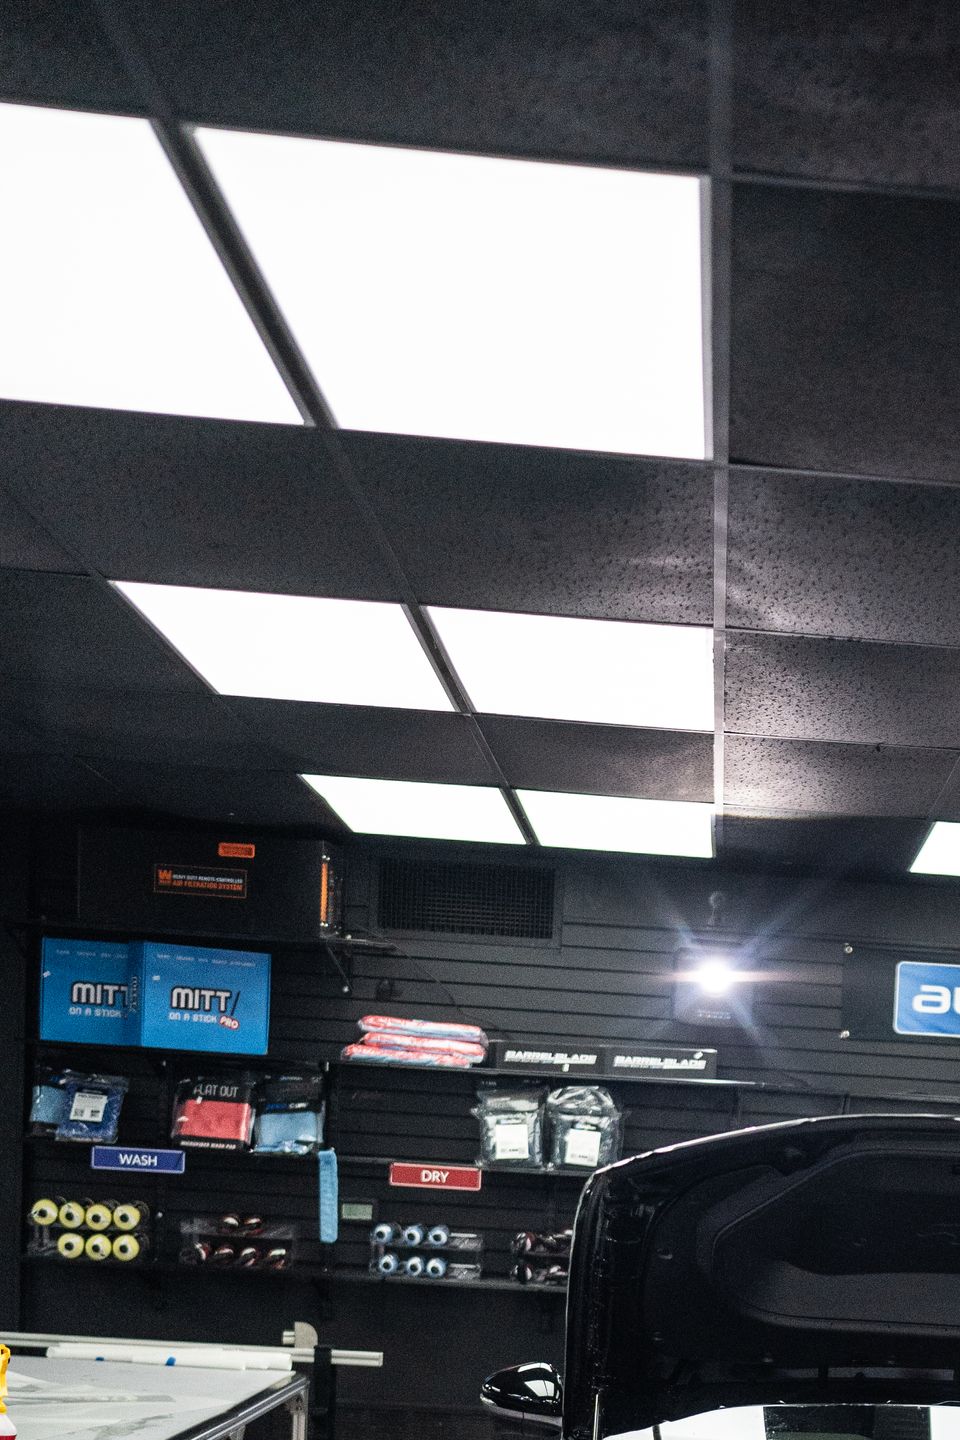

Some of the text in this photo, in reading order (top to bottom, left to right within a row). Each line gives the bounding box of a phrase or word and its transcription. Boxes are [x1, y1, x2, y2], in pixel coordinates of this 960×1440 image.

[171, 987, 231, 1012] MITT
[220, 1016, 239, 1029] PRO
[219, 1085, 240, 1098] OUT
[119, 1153, 158, 1166] WASH
[421, 1169, 449, 1183] DRY
